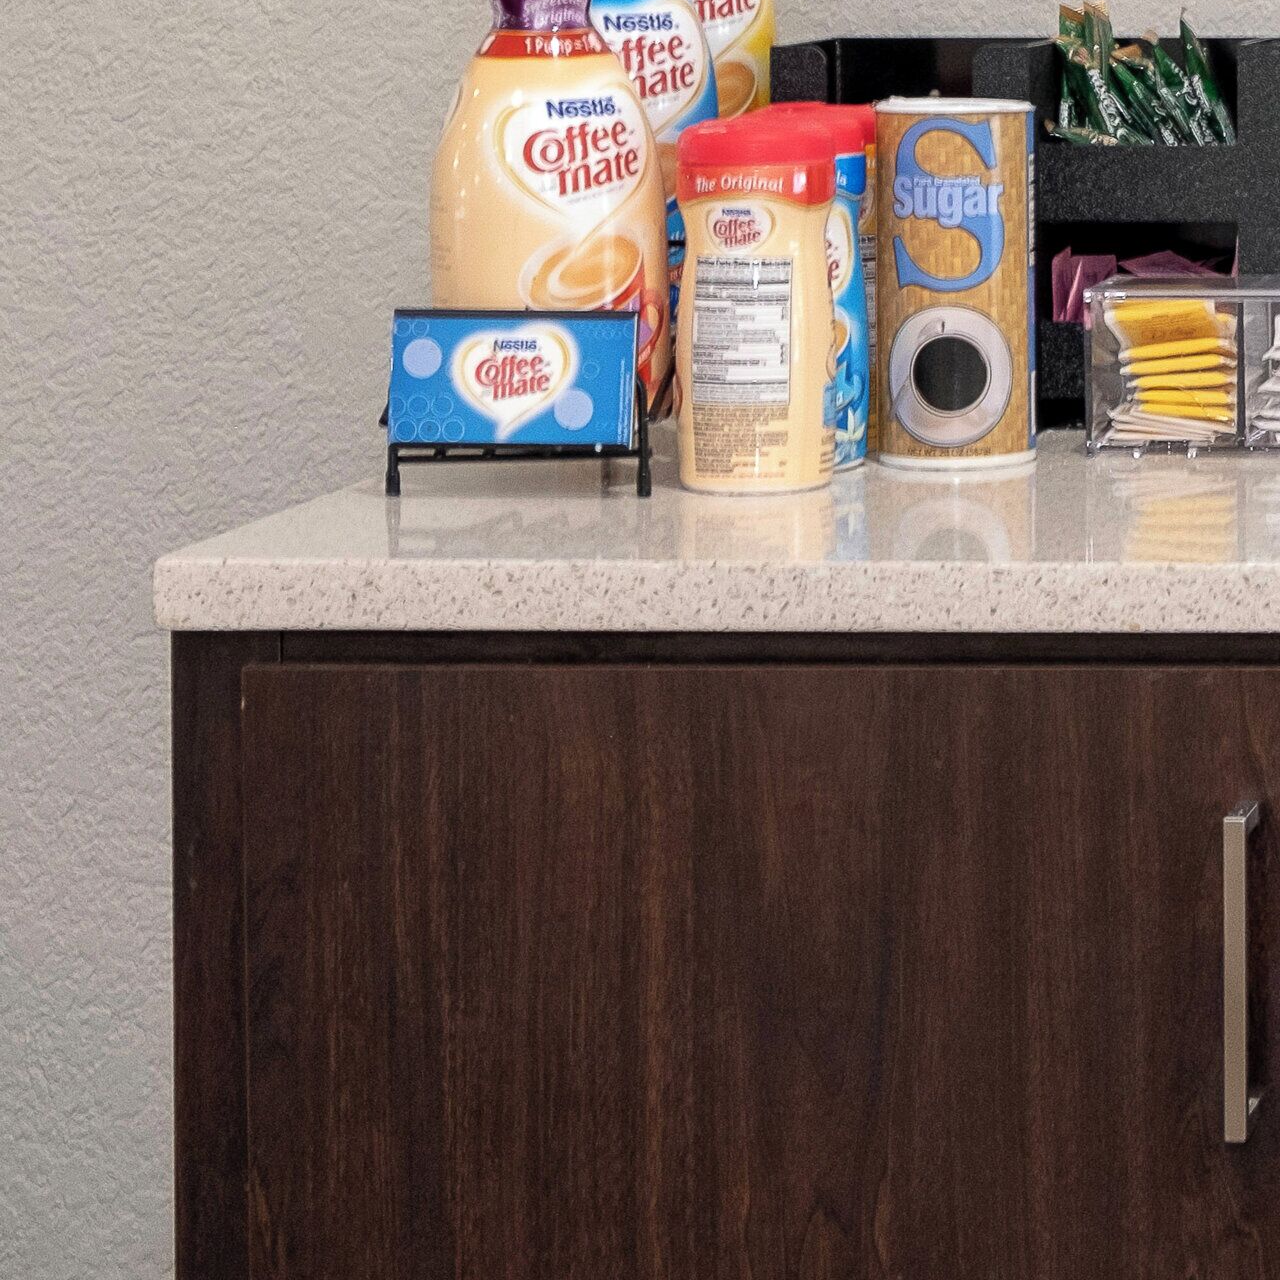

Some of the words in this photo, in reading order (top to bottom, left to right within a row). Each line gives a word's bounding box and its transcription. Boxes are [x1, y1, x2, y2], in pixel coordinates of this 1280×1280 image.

[558, 149, 639, 196] mate
[721, 173, 783, 193] Original
[492, 372, 550, 401] mate
